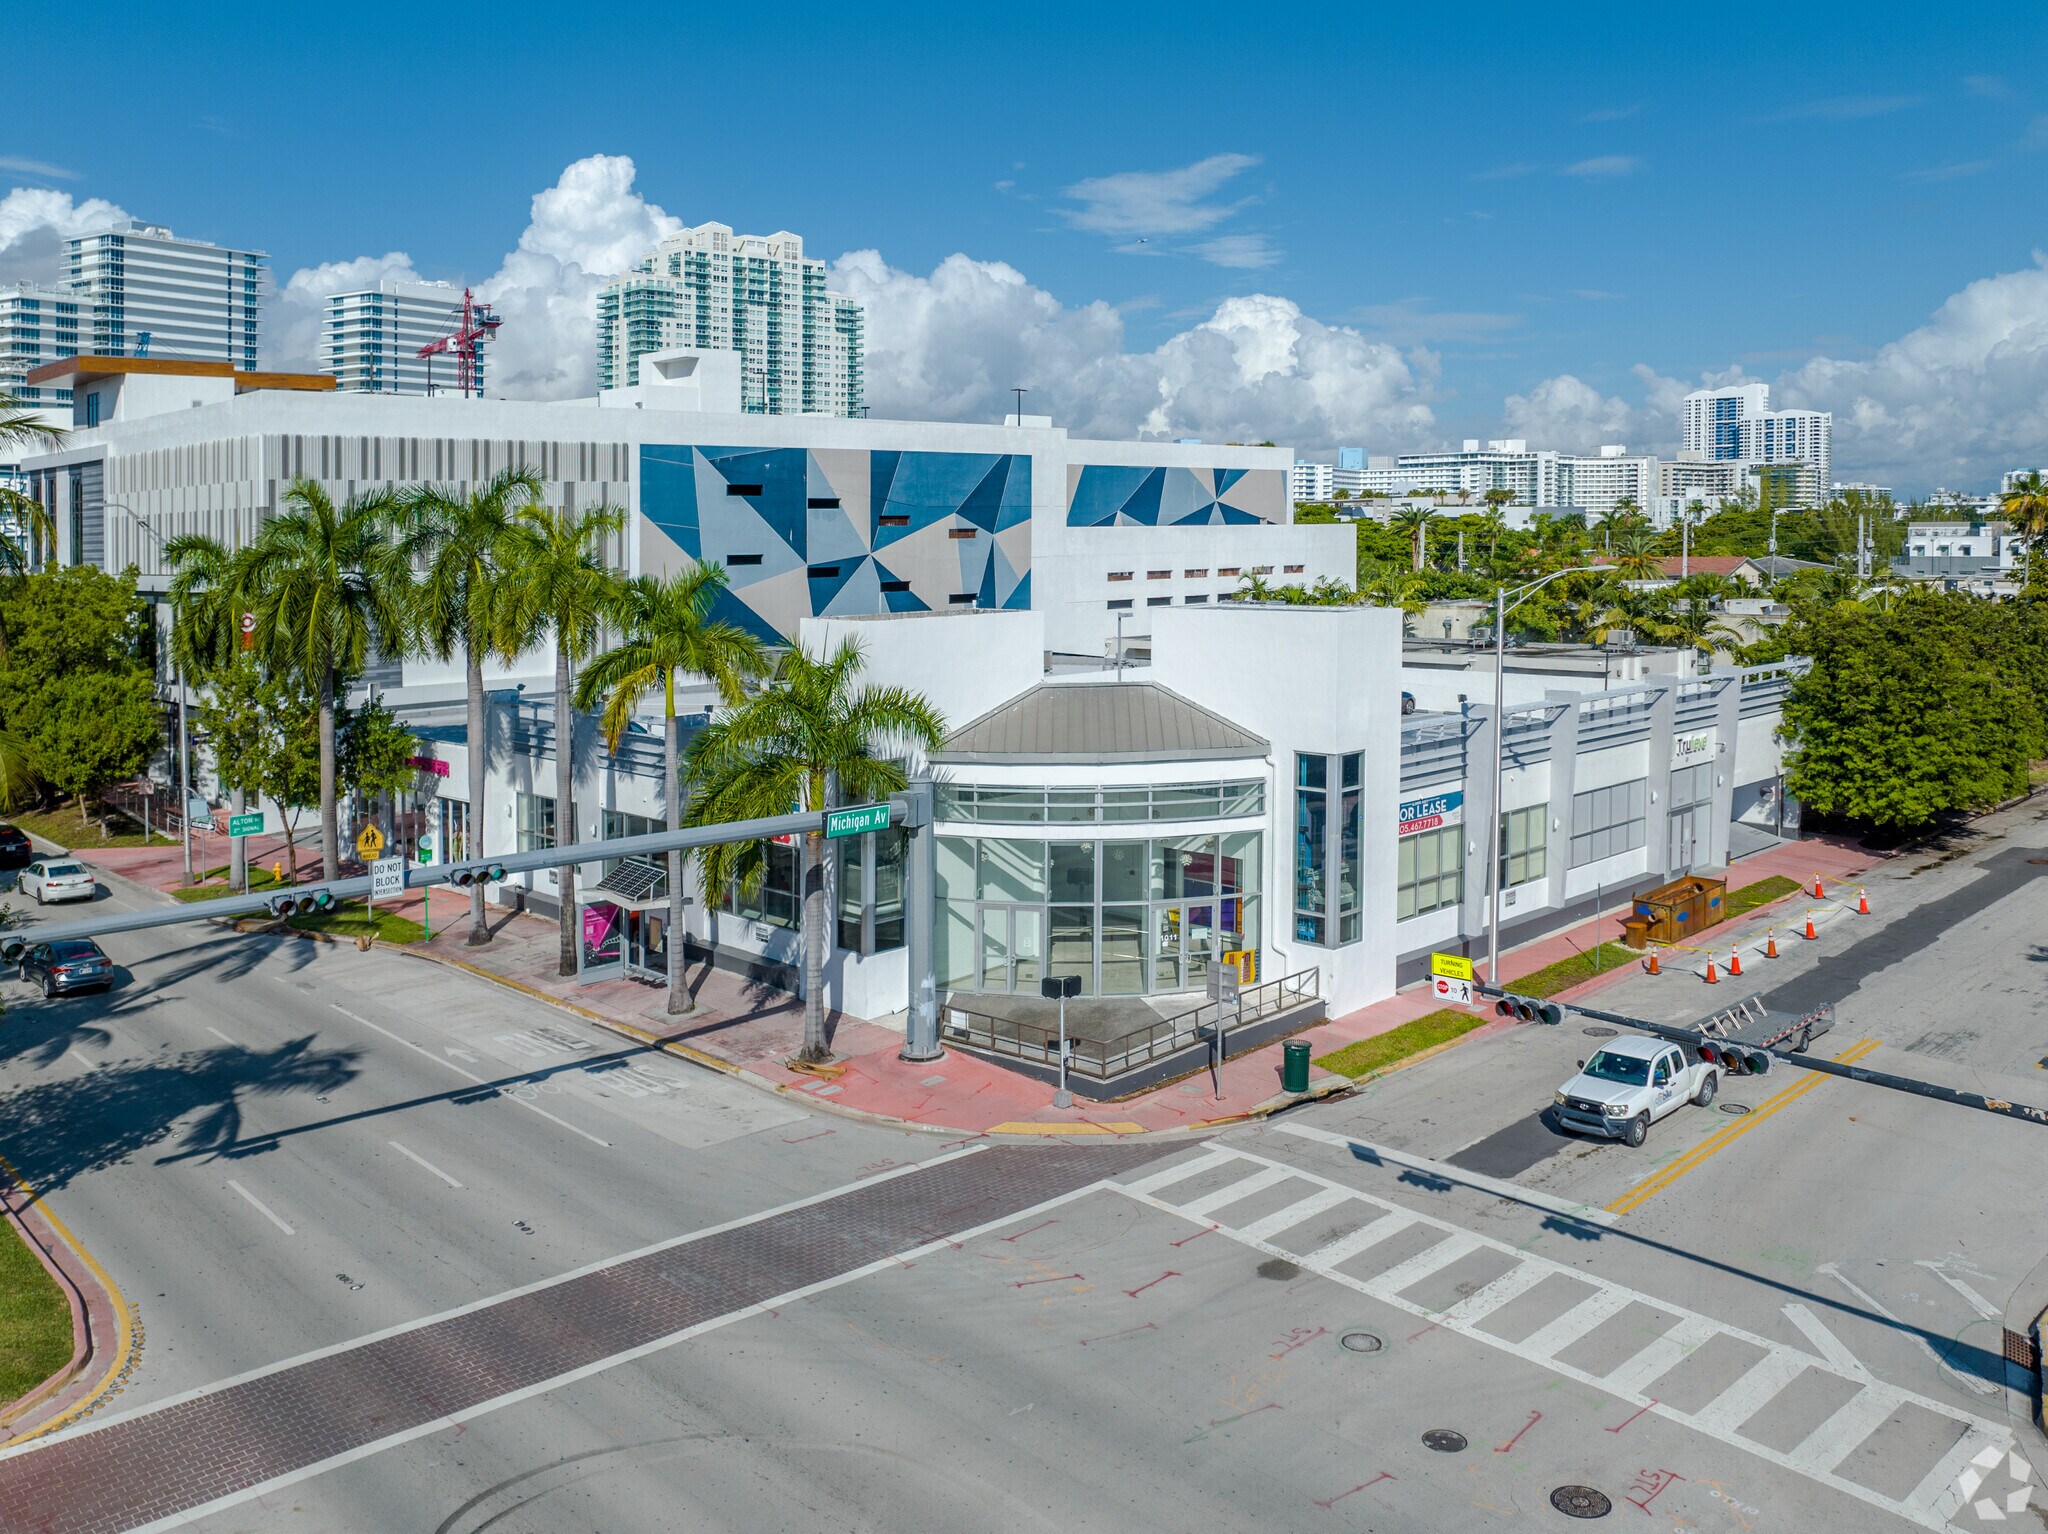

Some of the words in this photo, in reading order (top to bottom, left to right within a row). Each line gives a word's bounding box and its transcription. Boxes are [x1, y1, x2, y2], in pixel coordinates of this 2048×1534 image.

[1417, 799, 1447, 817] LEASE
[232, 817, 253, 826] ALTON
[831, 813, 870, 832] Michigan
[874, 809, 886, 825] Av
[242, 825, 260, 833] SIGNAL
[374, 865, 385, 874] DO
[387, 862, 401, 872] NOT
[375, 875, 400, 887] BLOCK
[1160, 934, 1178, 942] 1011
[1440, 959, 1464, 968] TURNING
[1440, 968, 1464, 977] VEHICLES
[586, 1064, 691, 1098] BUS
